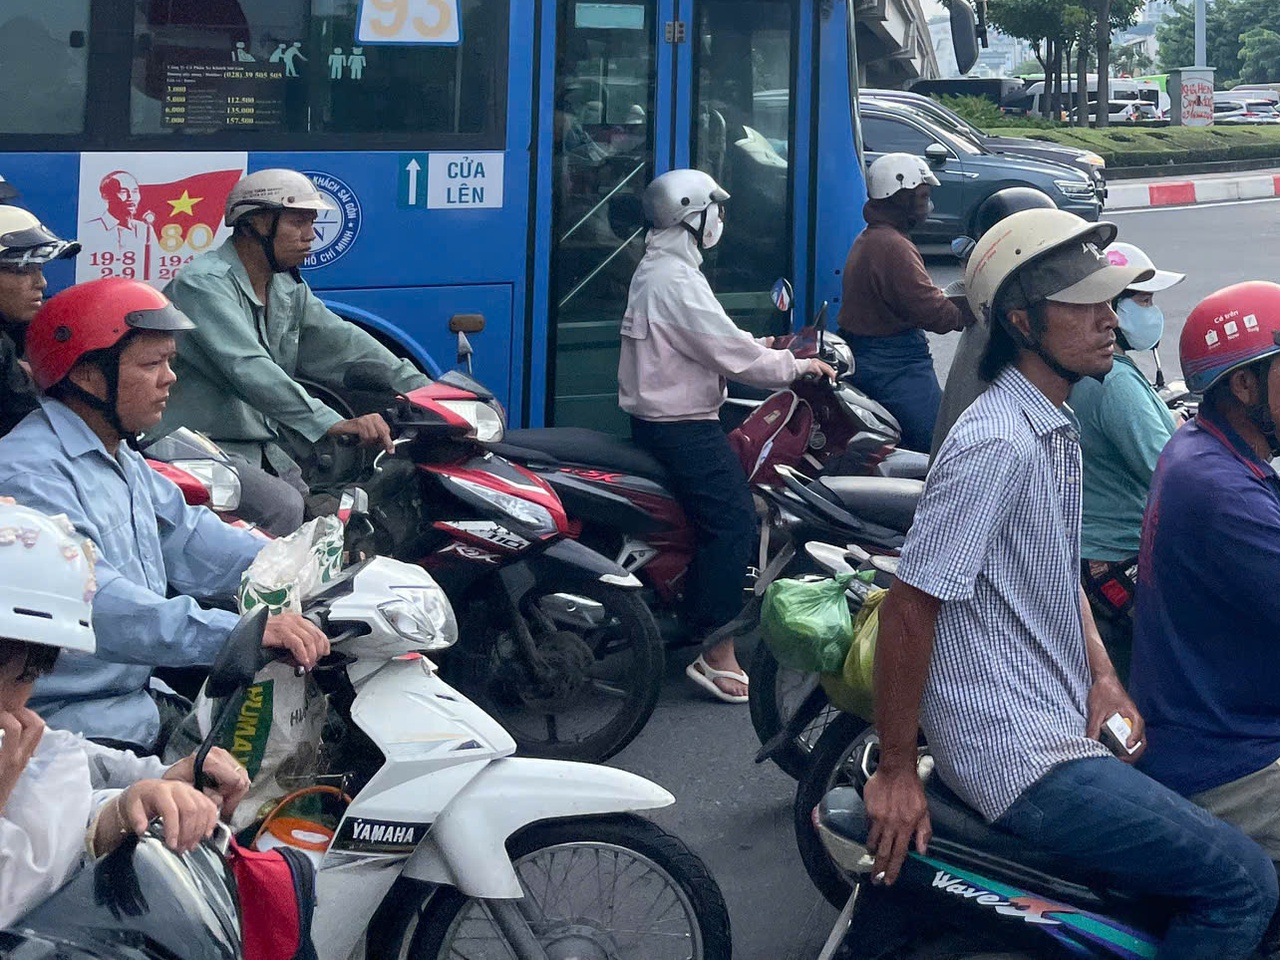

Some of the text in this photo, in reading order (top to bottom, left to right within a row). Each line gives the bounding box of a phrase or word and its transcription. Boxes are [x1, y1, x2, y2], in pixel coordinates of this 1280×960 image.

[447, 156, 486, 179] CỬA
[313, 175, 340, 192] KHÁCH
[446, 184, 485, 204] LÊN
[158, 223, 214, 252] 80
[335, 230, 354, 252] MINH
[90, 251, 136, 266] 19-8
[101, 267, 136, 279] 2-9
[353, 822, 415, 843] YAMAHA
[931, 870, 1011, 906] Wave
